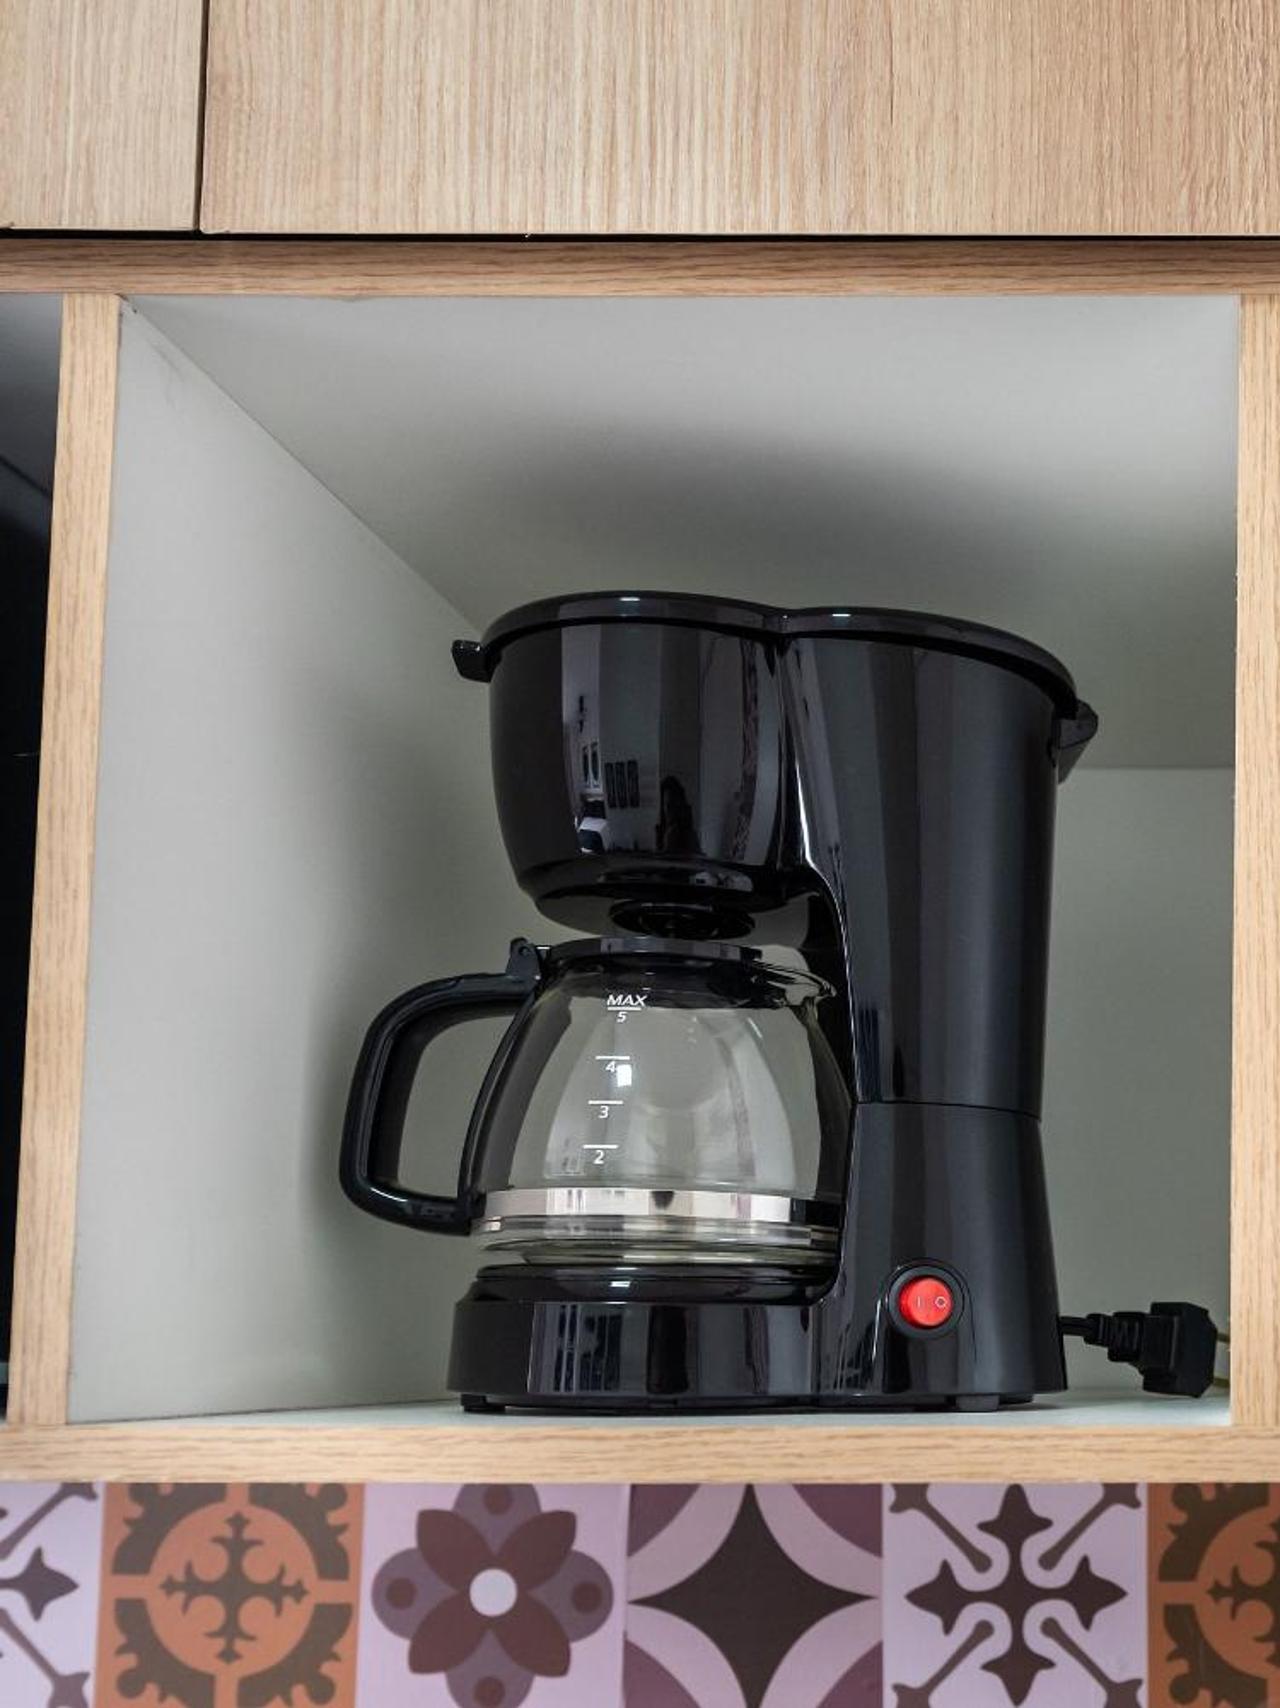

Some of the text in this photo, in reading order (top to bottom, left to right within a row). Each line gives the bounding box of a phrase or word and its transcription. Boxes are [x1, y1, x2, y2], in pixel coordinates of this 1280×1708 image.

[606, 994, 648, 1007] MAX
[617, 1011, 628, 1023] 5
[605, 1060, 617, 1073] 4
[599, 1105, 610, 1119] 3
[593, 1149, 605, 1165] 2
